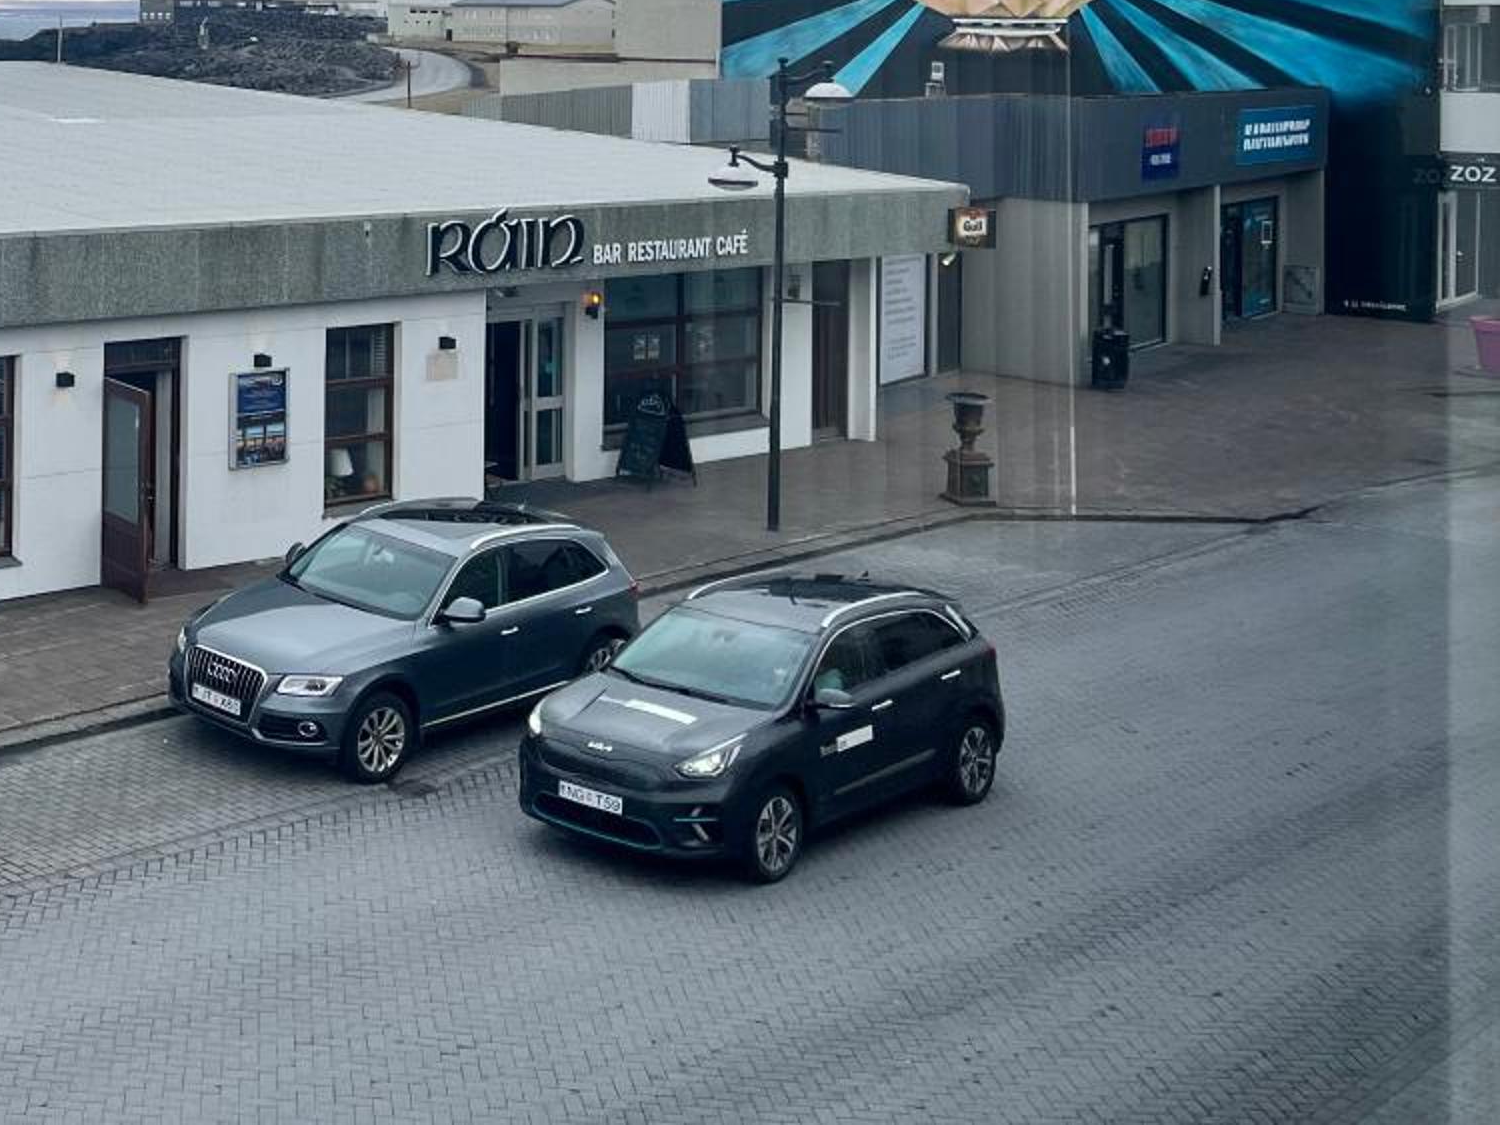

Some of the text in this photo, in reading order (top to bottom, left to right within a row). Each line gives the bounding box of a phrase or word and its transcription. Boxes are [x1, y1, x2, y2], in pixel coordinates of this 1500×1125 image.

[1450, 165, 1497, 182] ZOZ
[593, 228, 749, 265] BAR RESTAURANT CAFÉ
